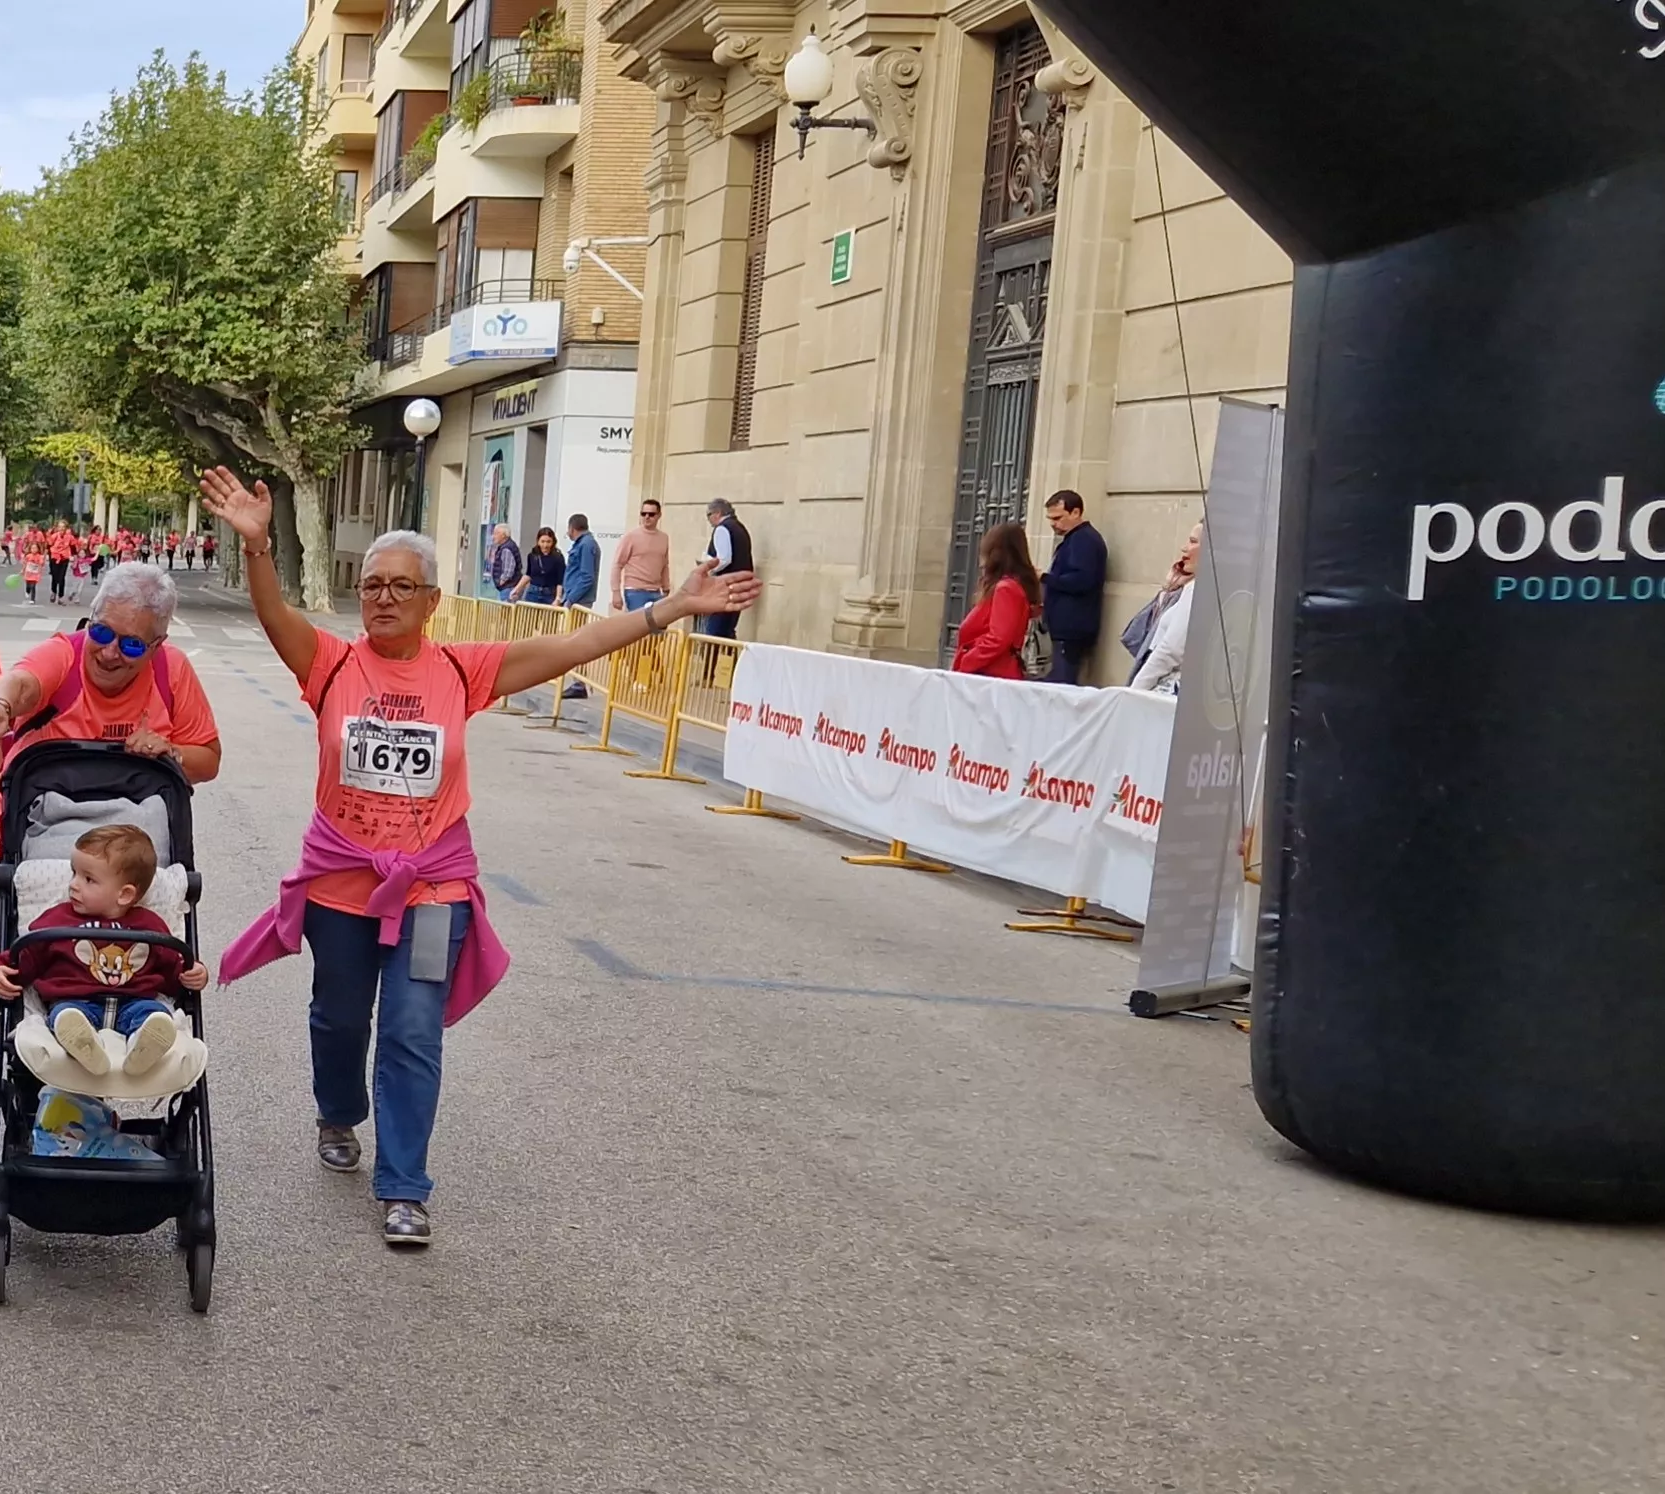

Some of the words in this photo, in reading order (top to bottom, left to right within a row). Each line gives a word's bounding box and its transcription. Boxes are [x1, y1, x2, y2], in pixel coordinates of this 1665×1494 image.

[1495, 575, 1665, 601] PODOLO
[352, 741, 431, 775] 1679
[758, 698, 803, 738] Alcampo
[812, 711, 866, 757] Alcampo
[876, 727, 936, 775] Alcampo
[945, 743, 1009, 794] Alcampo
